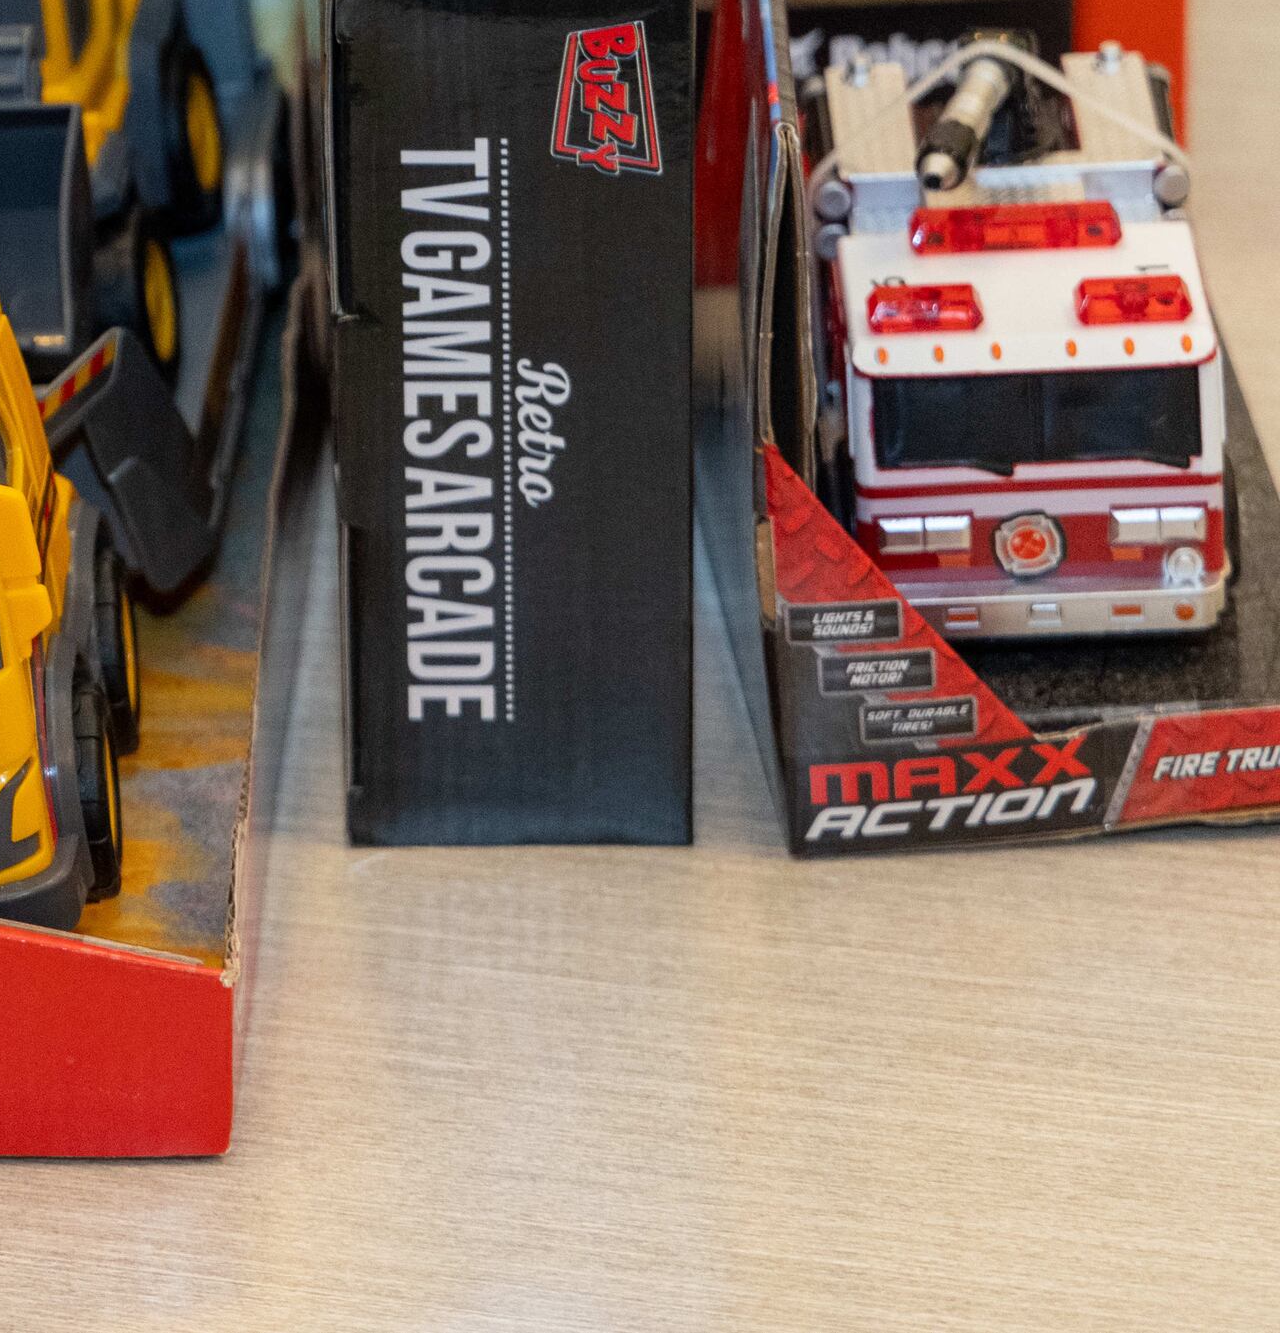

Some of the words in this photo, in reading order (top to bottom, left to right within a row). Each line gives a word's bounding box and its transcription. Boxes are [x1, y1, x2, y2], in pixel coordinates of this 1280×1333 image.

[399, 136, 490, 221] TV
[400, 231, 493, 460] GAMES
[517, 357, 572, 509] Retro
[403, 465, 497, 723] ARCADE
[812, 611, 864, 625] LIGHTS
[812, 622, 875, 637] SOUNDS!
[846, 659, 910, 675] FRICTION
[850, 672, 904, 687] MOTOR!
[867, 709, 902, 721] SOFT
[907, 704, 970, 719] DURABLE
[892, 720, 934, 733] TIRES!
[809, 733, 1092, 805] MAXX
[1153, 751, 1217, 781] FIRE
[1226, 745, 1280, 773] TRU
[804, 777, 1097, 842] ACTION
